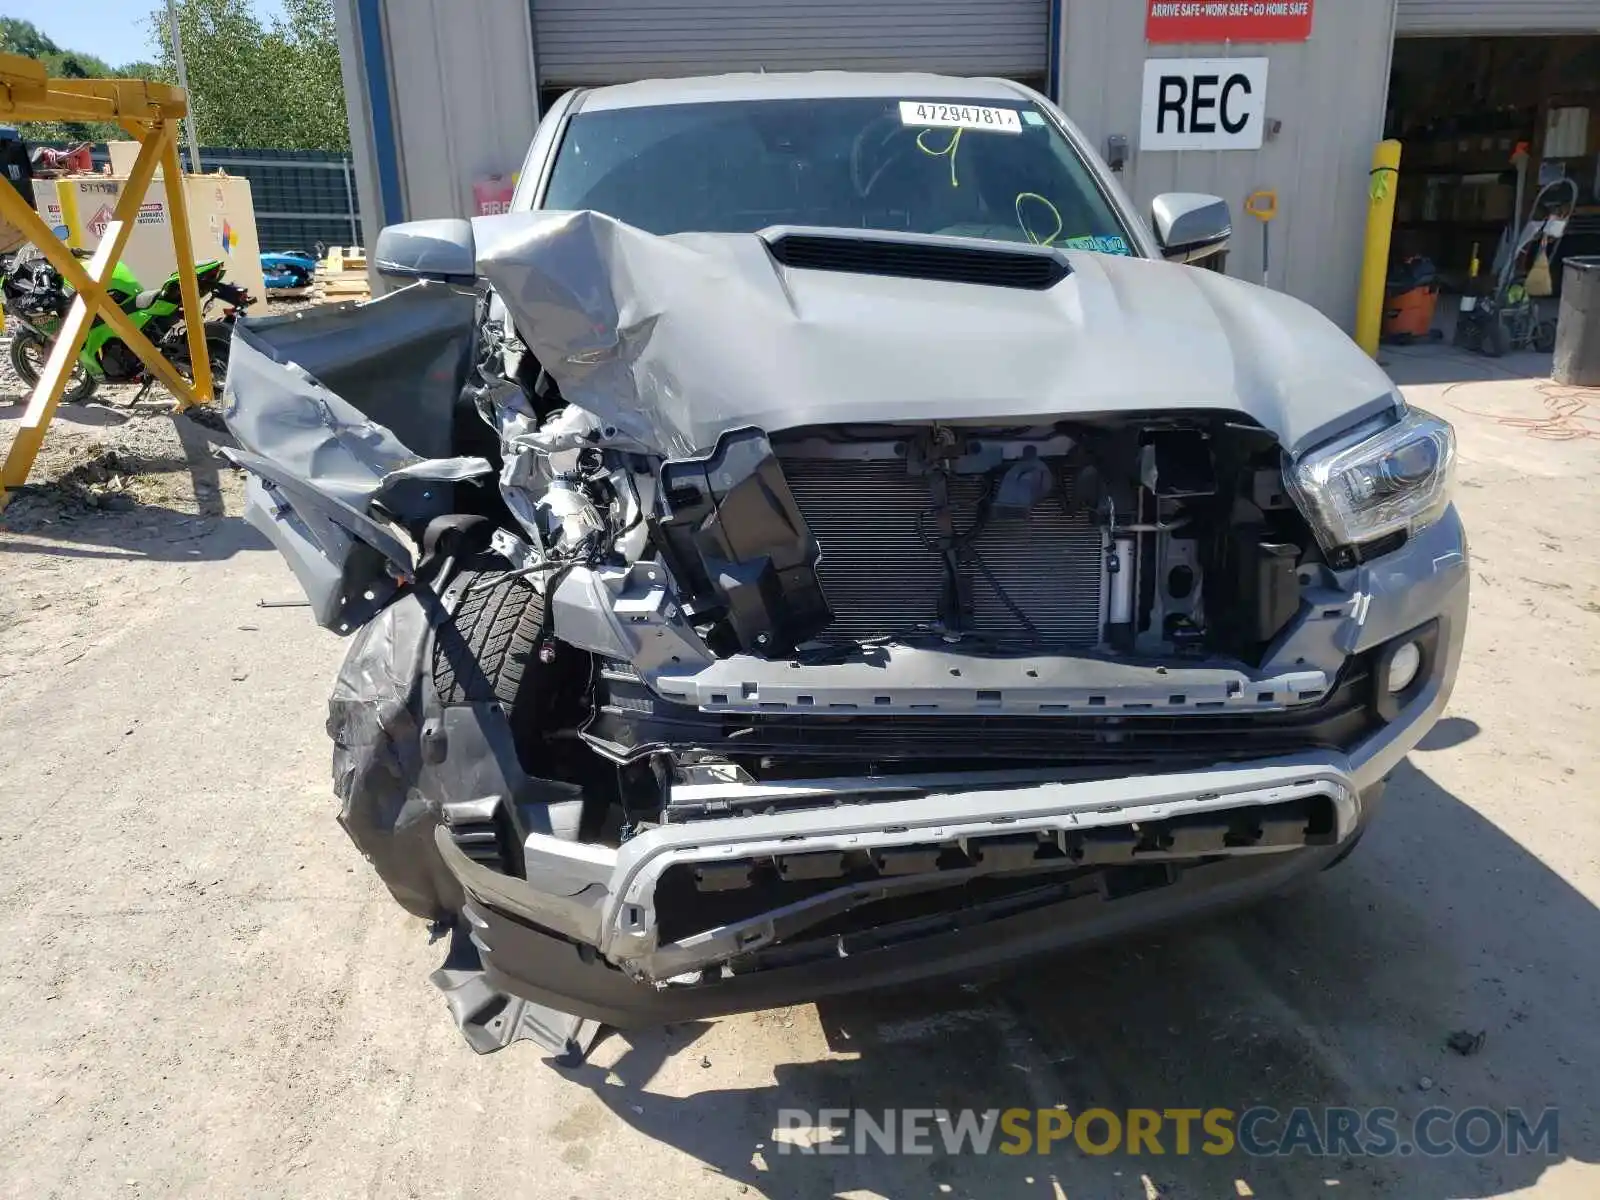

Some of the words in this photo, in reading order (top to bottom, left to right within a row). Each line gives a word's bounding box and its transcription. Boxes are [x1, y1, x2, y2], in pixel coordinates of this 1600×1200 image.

[1152, 4, 1180, 17] ARRIVE
[1181, 4, 1201, 16] SAFE
[1205, 4, 1229, 16] WORK
[1229, 4, 1249, 16] SAFE
[1254, 3, 1266, 16] GO
[1266, 3, 1289, 16] HOME
[1289, 2, 1309, 16] SAFE
[1157, 73, 1252, 134] REC
[916, 104, 1004, 125] 47294781
